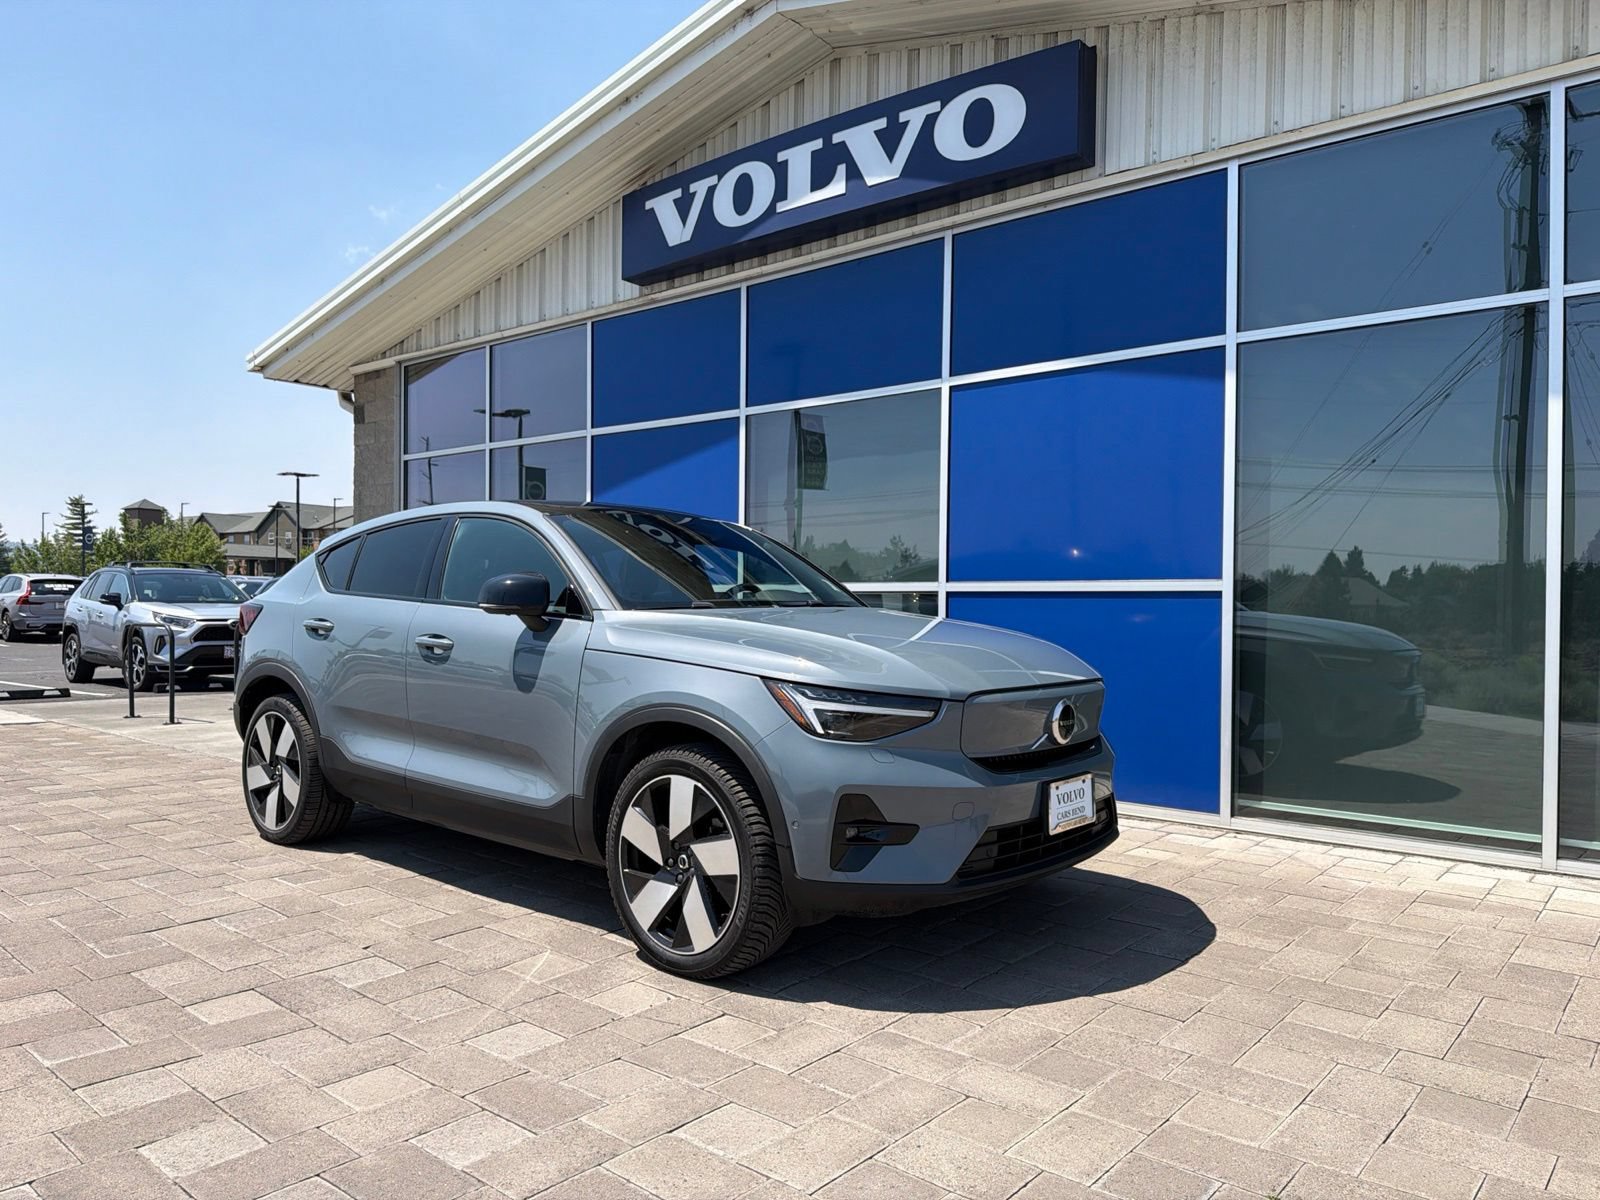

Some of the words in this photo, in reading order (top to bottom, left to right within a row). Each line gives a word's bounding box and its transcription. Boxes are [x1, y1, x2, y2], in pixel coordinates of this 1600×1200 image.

[644, 83, 1027, 248] VOLVO
[1056, 788, 1085, 805] VOLVO
[1057, 810, 1071, 820] CARS
